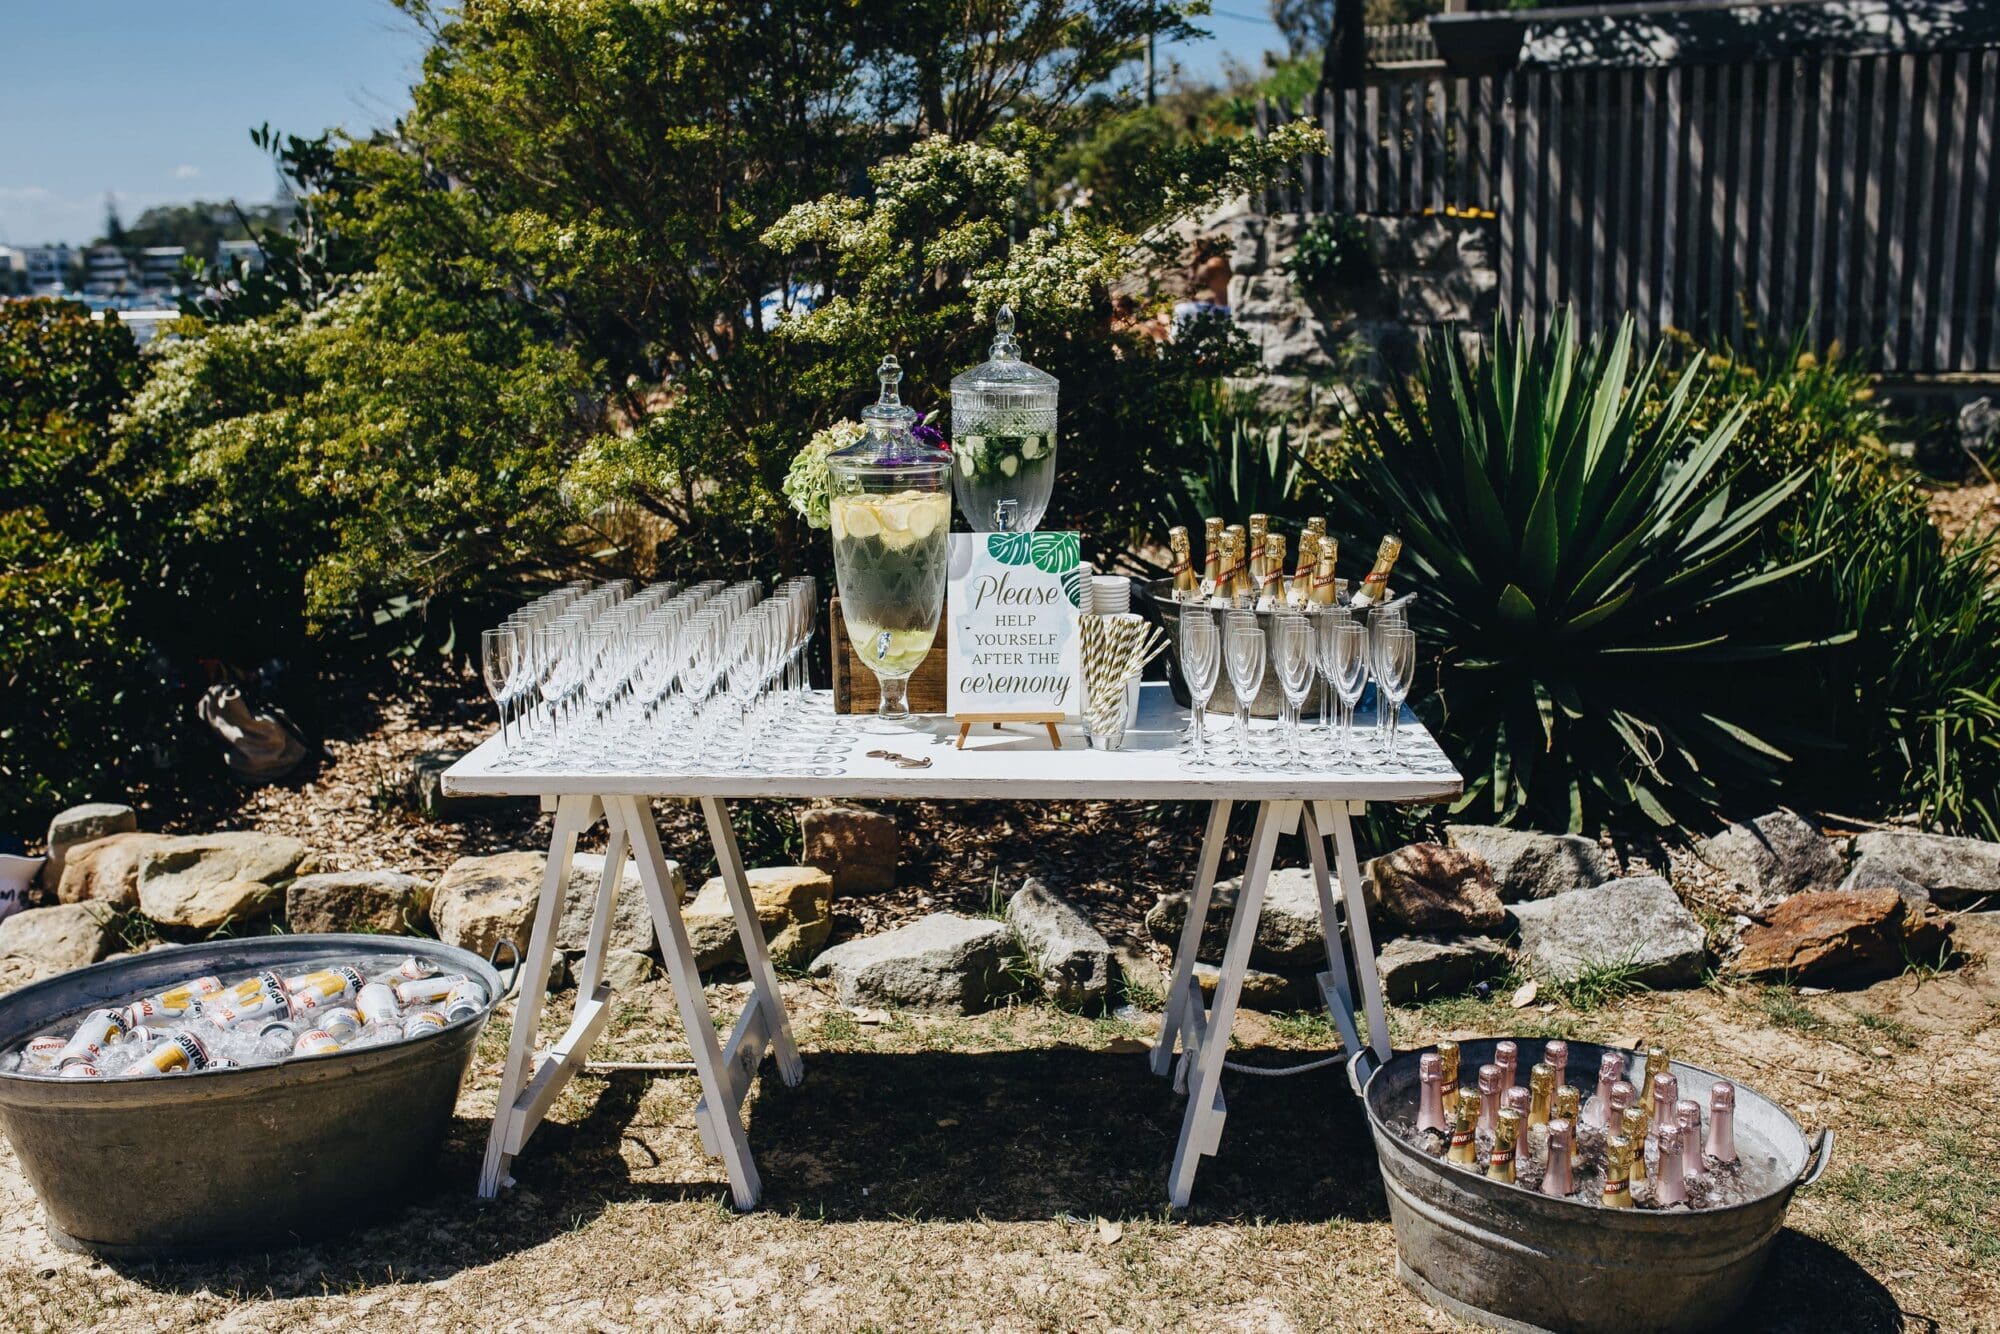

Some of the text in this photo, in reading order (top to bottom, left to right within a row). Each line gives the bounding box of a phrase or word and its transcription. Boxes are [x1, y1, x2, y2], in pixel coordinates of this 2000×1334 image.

[973, 571, 1059, 610] Please
[995, 615, 1036, 627] HELP
[974, 634, 1059, 646] YOURSELF
[972, 653, 1060, 665] AFTER THE
[960, 672, 1071, 706] ceremony
